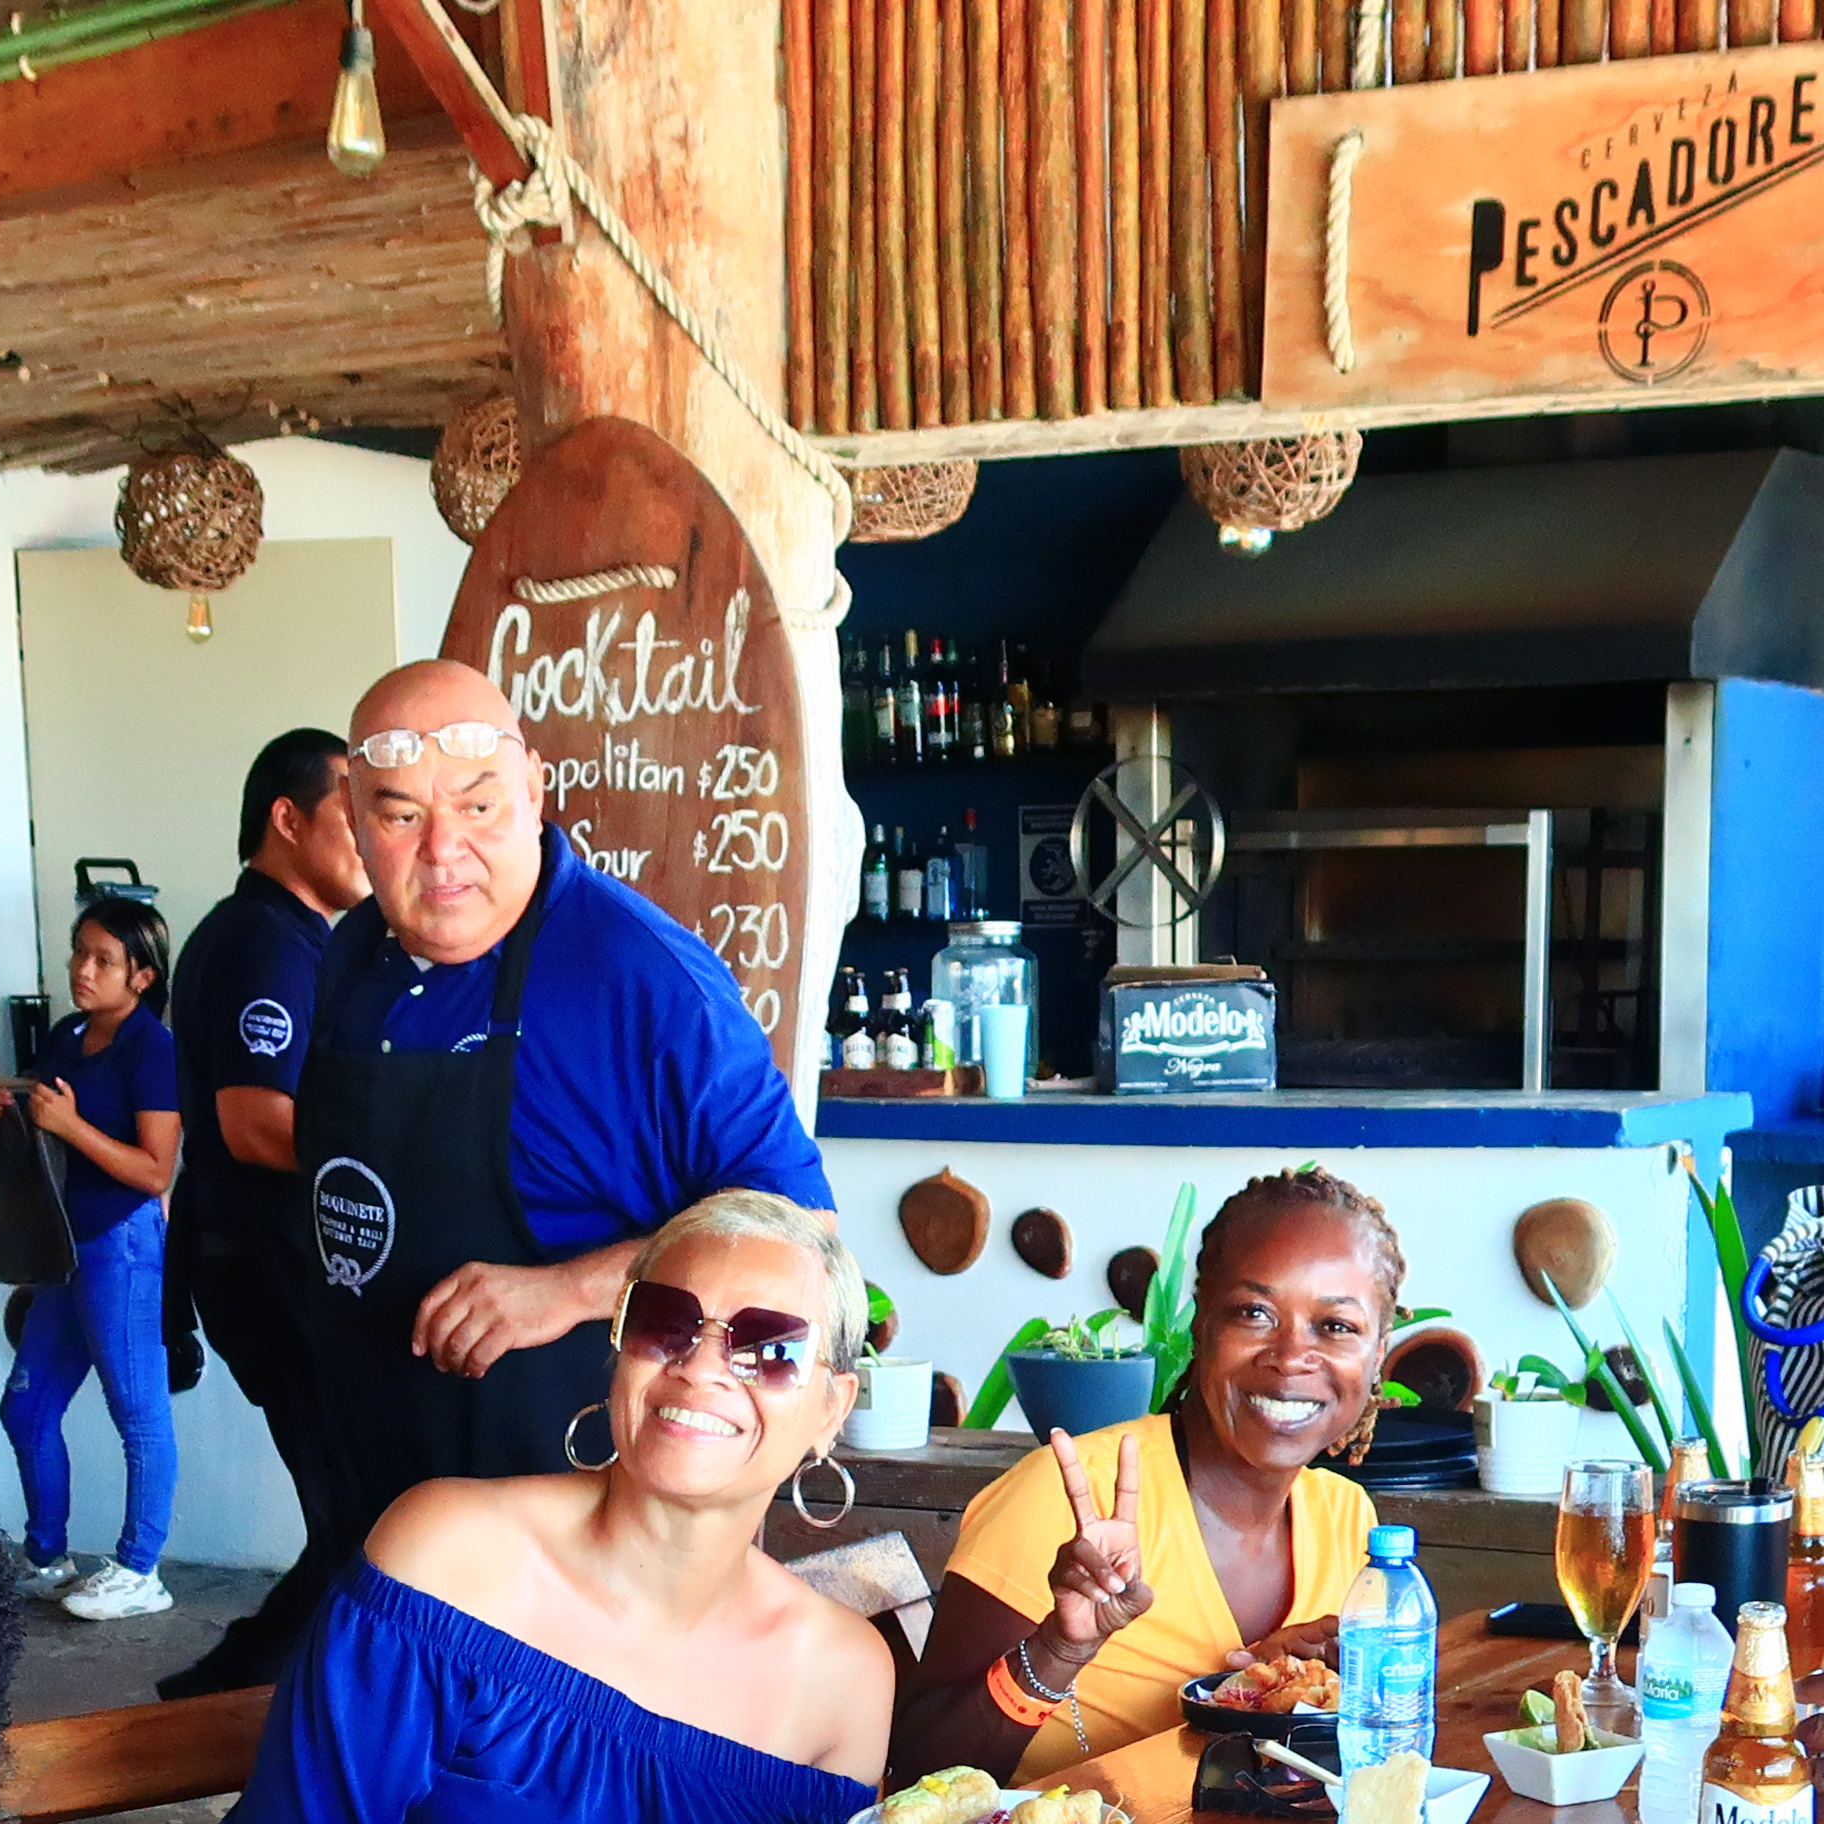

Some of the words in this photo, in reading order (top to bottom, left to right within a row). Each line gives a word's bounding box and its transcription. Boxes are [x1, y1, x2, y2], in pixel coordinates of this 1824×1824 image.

[1579, 71, 1740, 170] CERVEZA
[697, 743, 780, 800] $250
[692, 807, 789, 875] $250
[1143, 1001, 1243, 1038] Modelo
[1162, 1057, 1222, 1079] Negra
